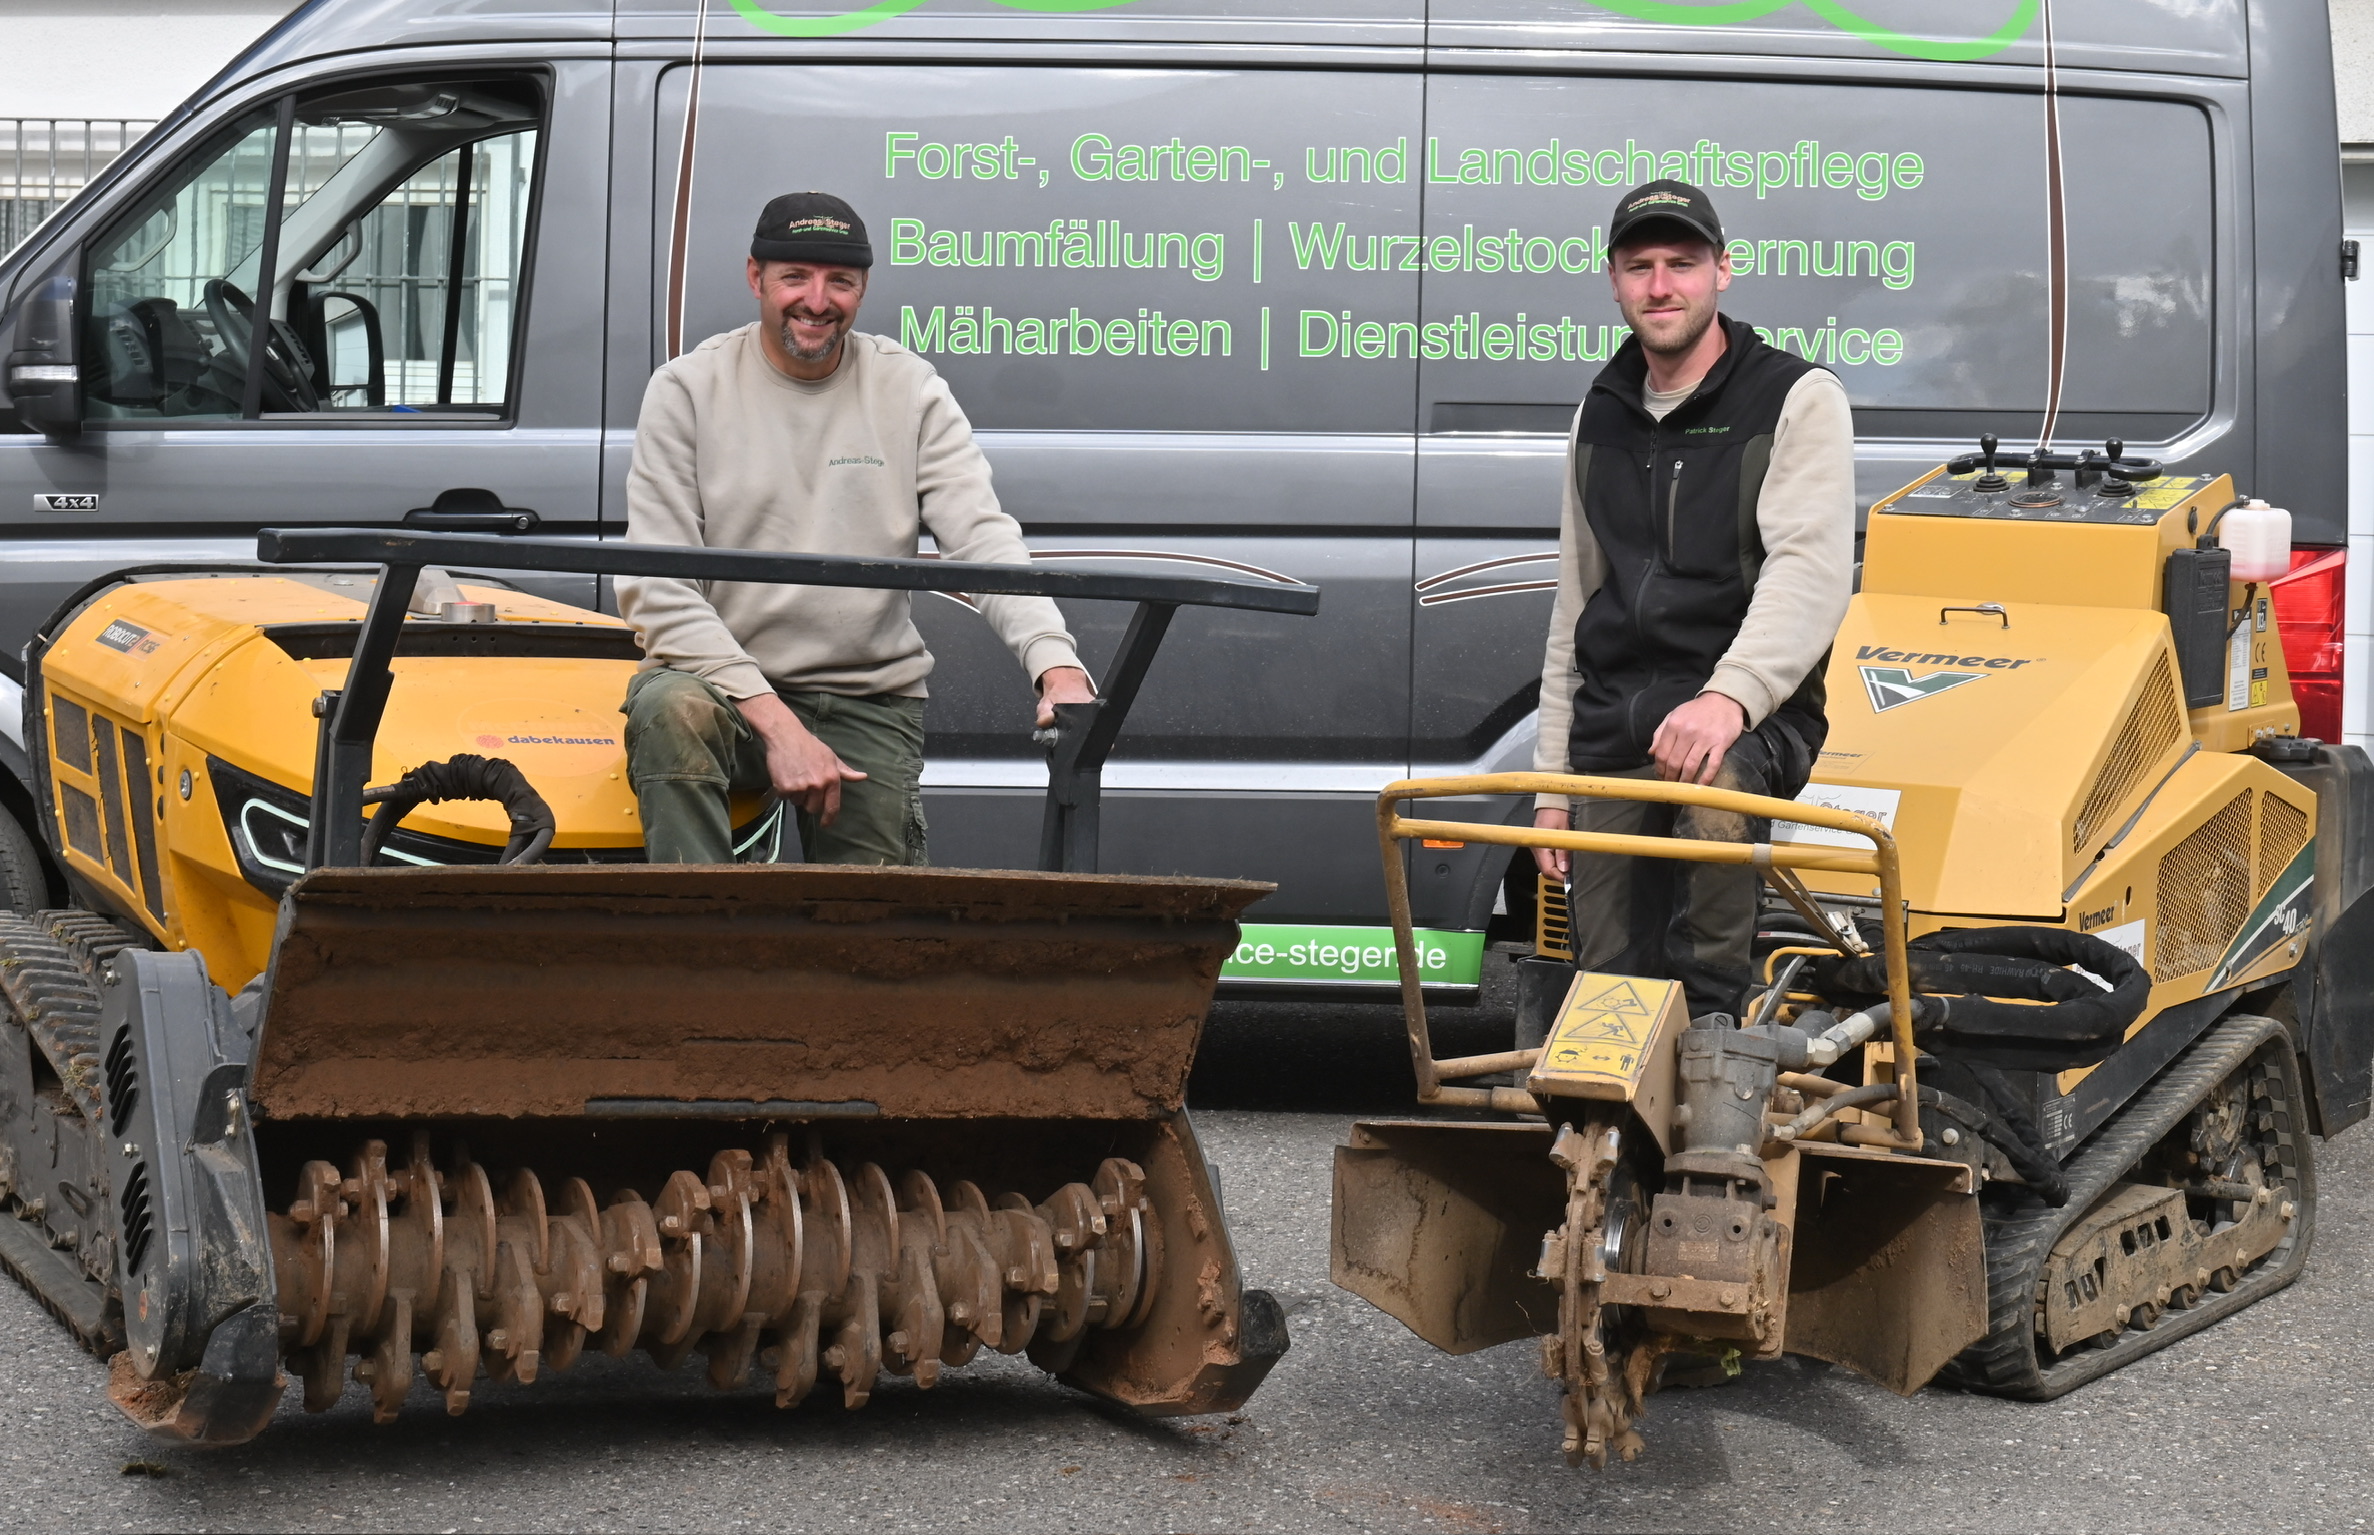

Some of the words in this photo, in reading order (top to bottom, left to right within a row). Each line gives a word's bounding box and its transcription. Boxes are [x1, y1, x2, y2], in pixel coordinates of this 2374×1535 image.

[885, 132, 1050, 188] Forst-,
[1070, 133, 1285, 190] Garten-,
[1305, 137, 1407, 184] und
[1428, 137, 1925, 201] Landschaftspflege
[890, 218, 1224, 281] Baumfällung
[900, 306, 1232, 355] Mäharbeiten
[53, 496, 94, 509] 4x4
[1855, 645, 2032, 670] Vermeer
[507, 734, 615, 746] dabekausen
[1818, 749, 1864, 759] ermeer
[2078, 905, 2115, 933] Vermeer
